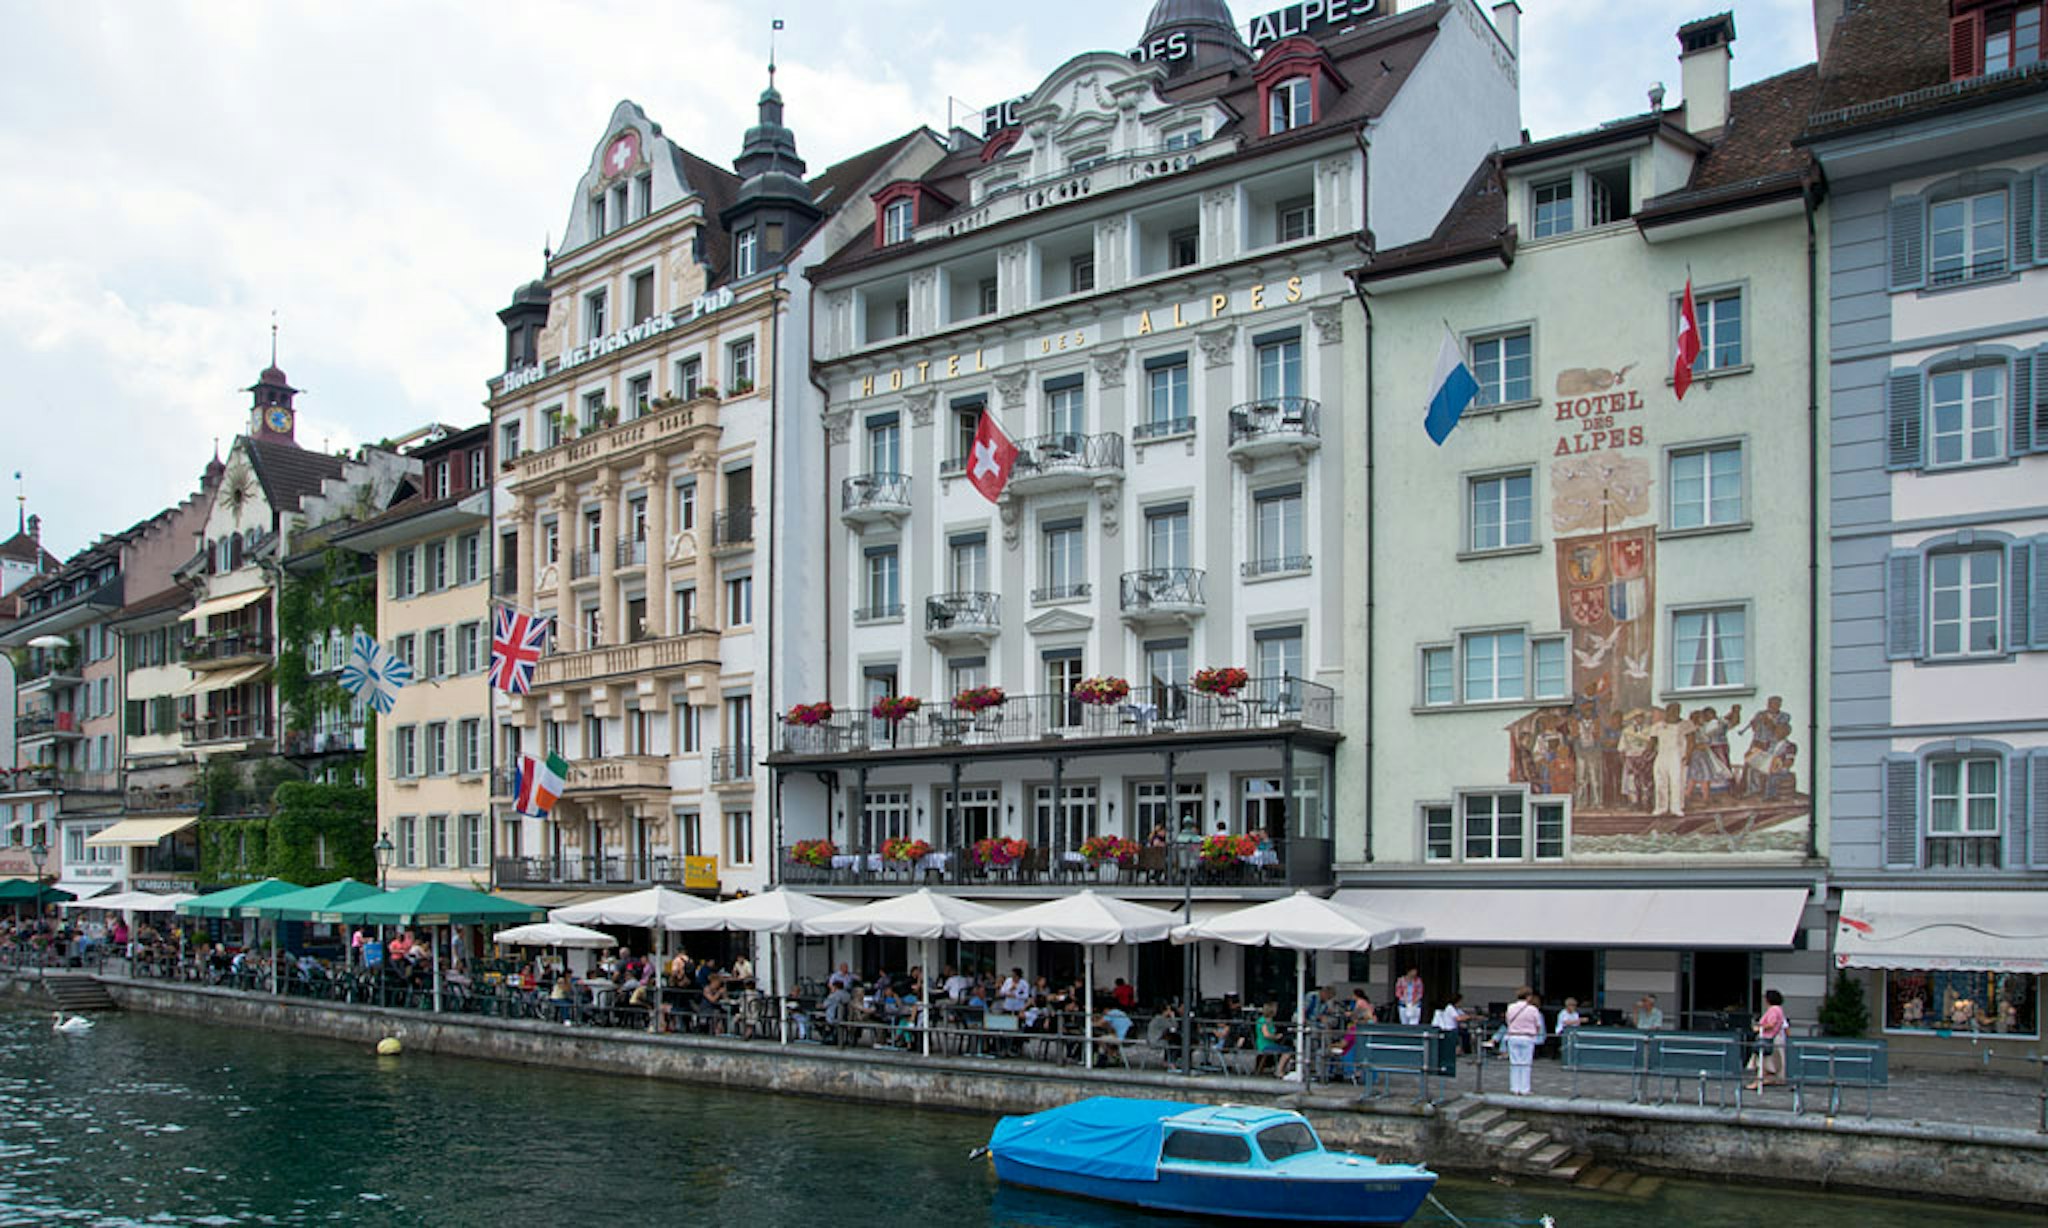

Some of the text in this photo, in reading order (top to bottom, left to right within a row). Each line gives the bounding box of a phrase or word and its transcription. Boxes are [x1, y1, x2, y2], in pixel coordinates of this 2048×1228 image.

[500, 360, 545, 396] Hotel
[588, 311, 676, 361] Pickwick
[691, 285, 735, 320] Pub
[862, 276, 1303, 397] HOTEL DES ALPES
[1555, 390, 1644, 422] HOTEL
[1582, 415, 1615, 432] DES
[1553, 425, 1644, 457] ALPES
